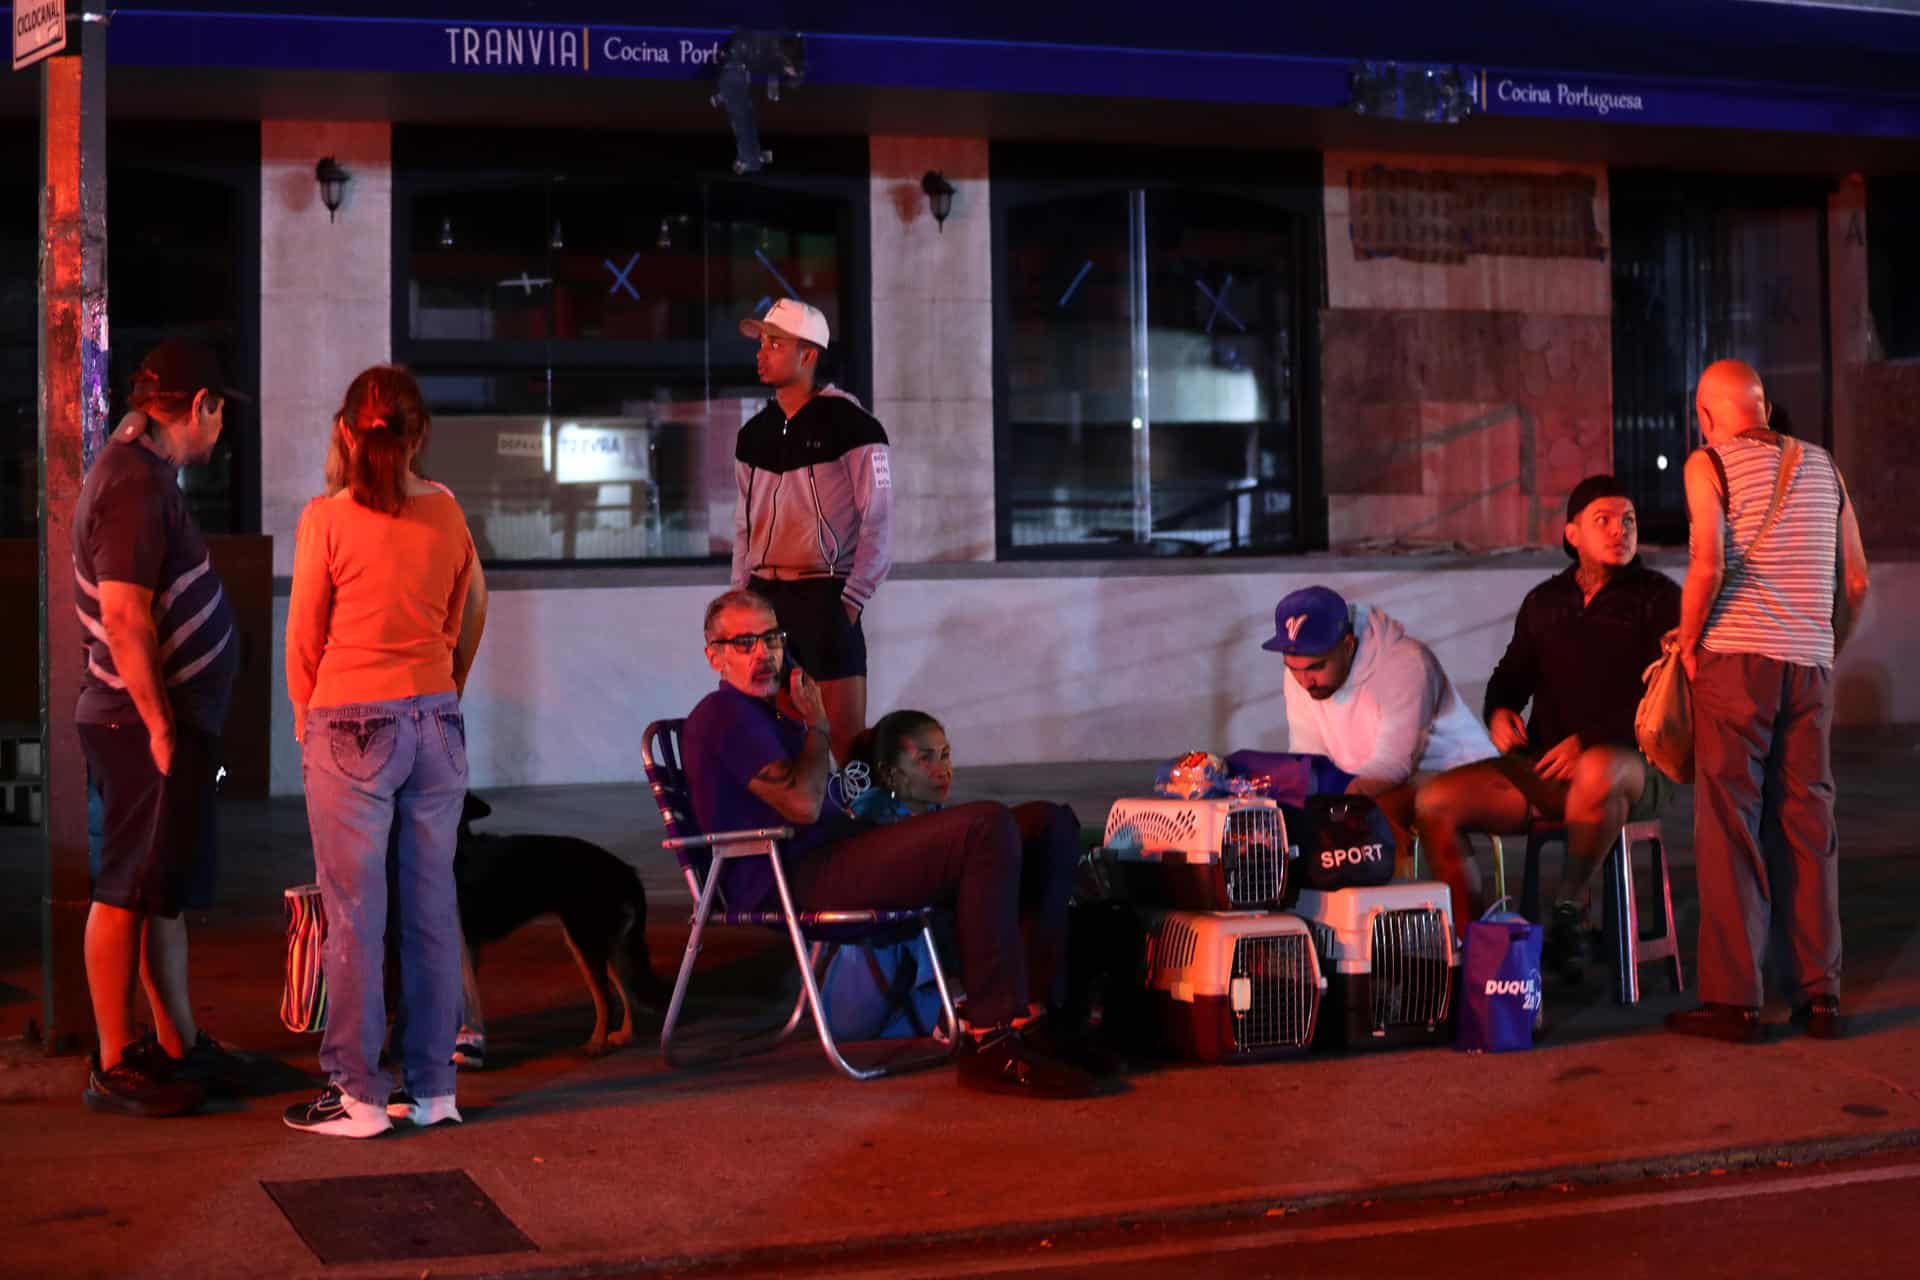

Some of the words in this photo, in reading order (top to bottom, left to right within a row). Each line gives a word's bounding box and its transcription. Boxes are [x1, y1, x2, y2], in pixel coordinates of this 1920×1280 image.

[445, 27, 578, 68] TRANVIA
[603, 36, 670, 63] Cocina
[1497, 79, 1551, 104] Cocina
[1556, 83, 1644, 114] Portuguesa
[1320, 843, 1384, 870] SPORT
